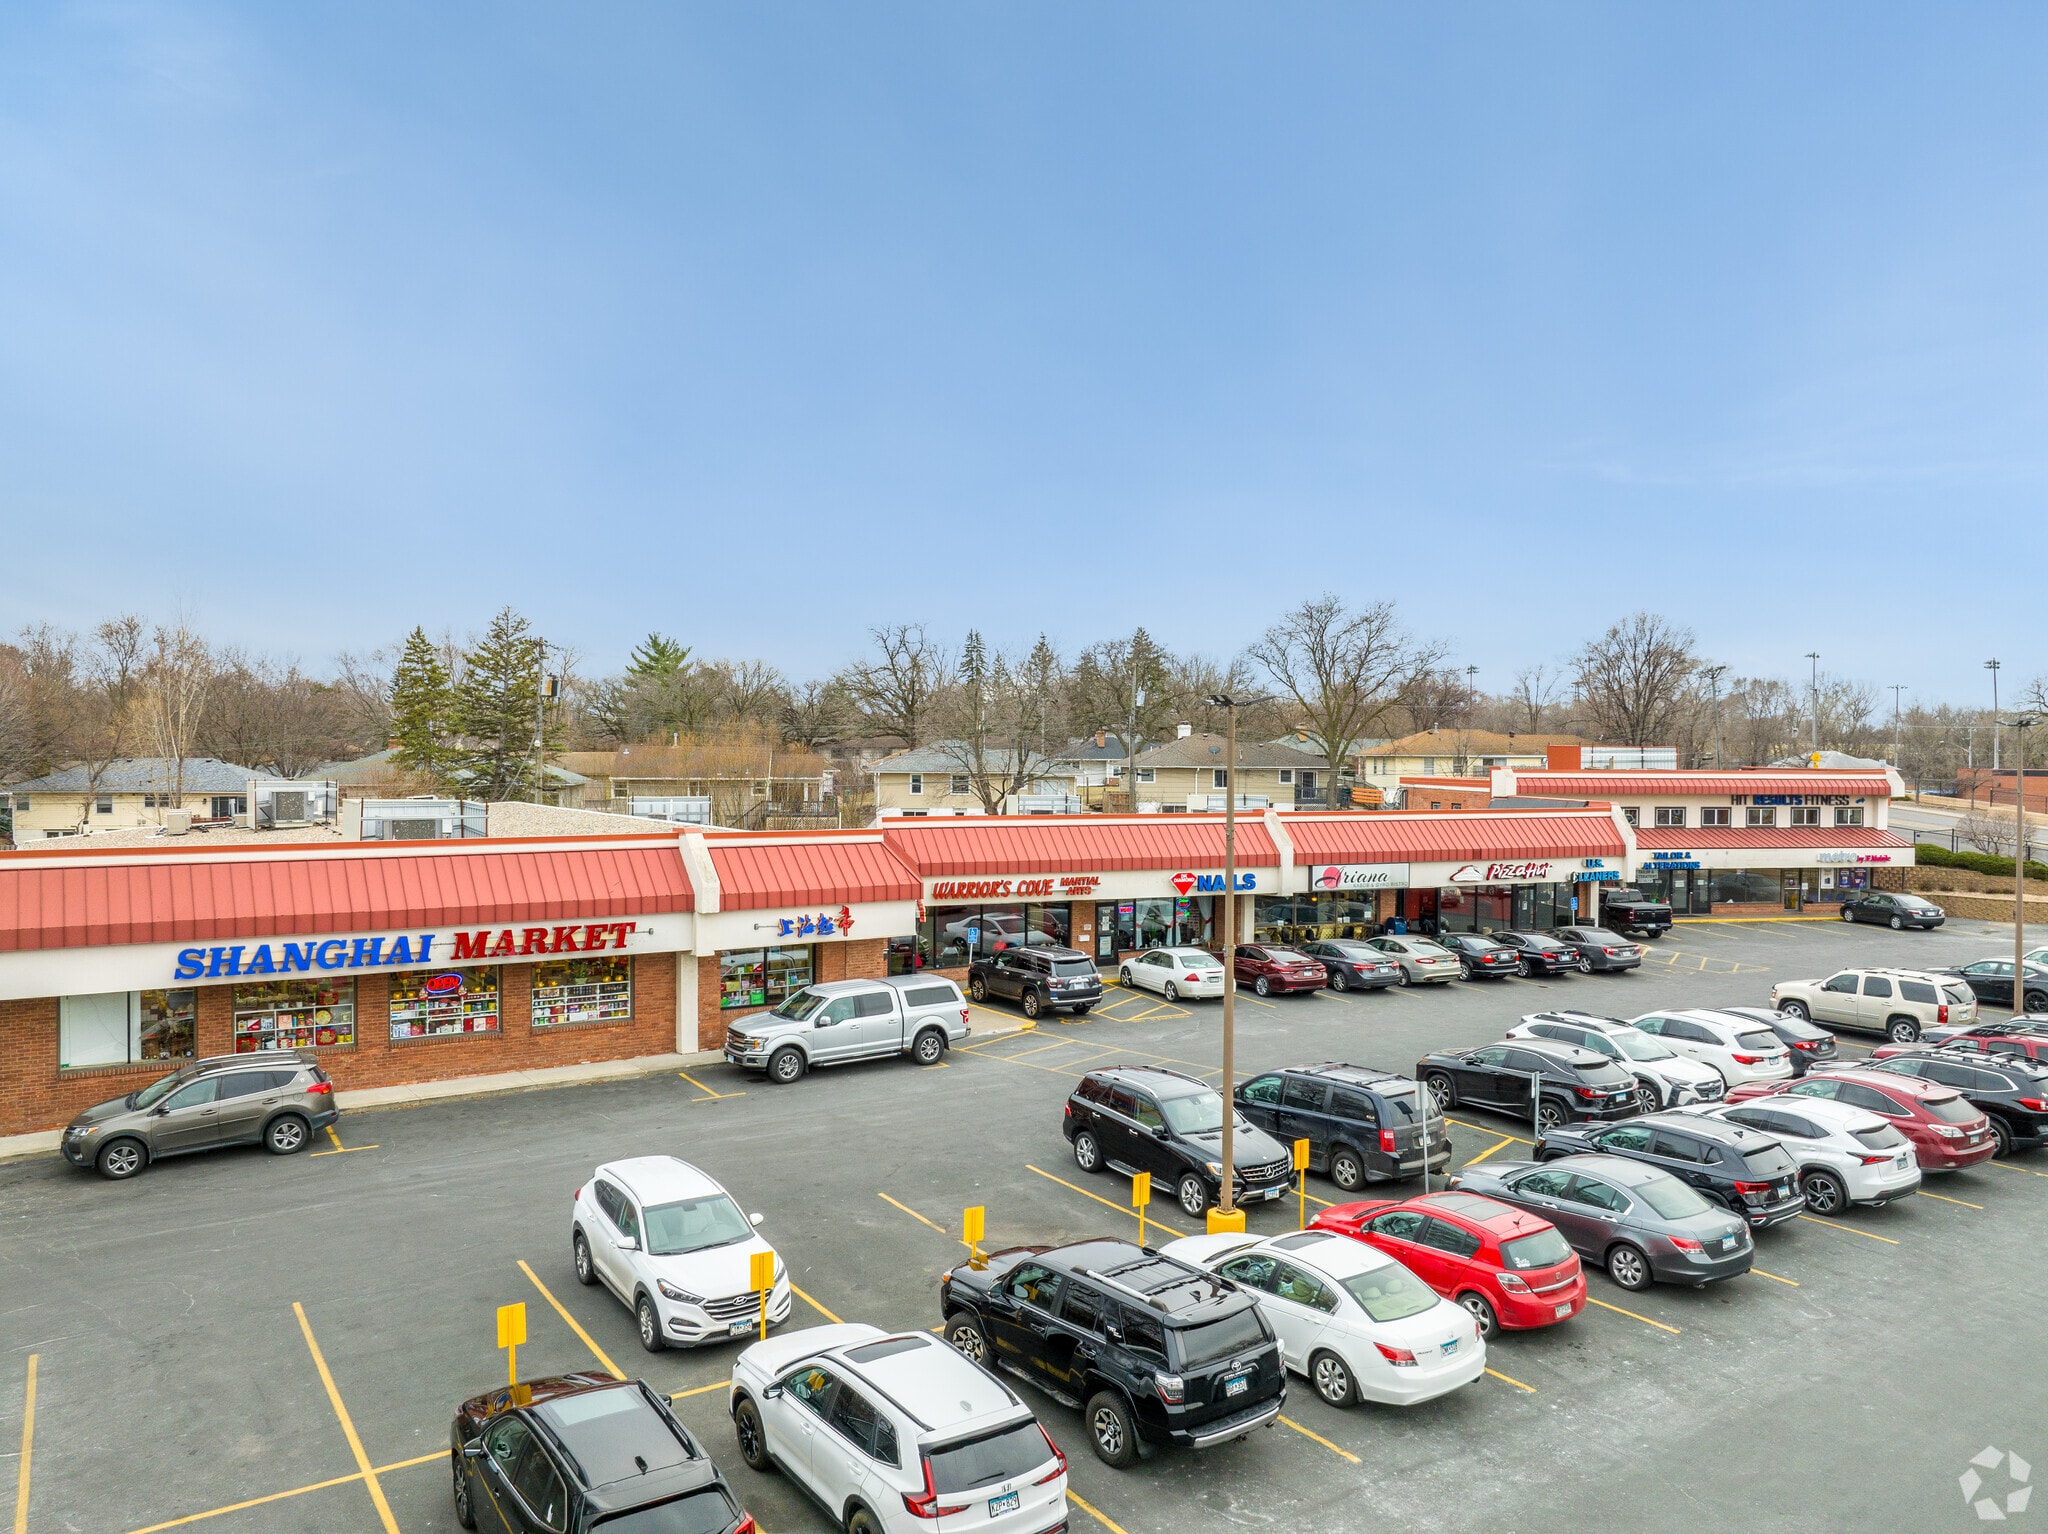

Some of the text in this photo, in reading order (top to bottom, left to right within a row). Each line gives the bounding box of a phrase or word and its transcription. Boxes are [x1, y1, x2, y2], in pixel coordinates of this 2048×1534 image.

[1731, 794, 1850, 806] HIT RESULTS FITNESS
[1487, 862, 1553, 880] Pizza Hut
[1586, 859, 1604, 868] U.S.
[1642, 861, 1701, 869] ALTERATIONS
[1060, 877, 1101, 886] MARTIAL
[1197, 873, 1256, 892] NALS
[1315, 866, 1389, 888] Ariana
[932, 879, 1055, 900] WARRIOR'S COVE
[1066, 886, 1092, 896] ARTS
[174, 921, 637, 980] SHANGHAI MARKET
[427, 975, 460, 991] OPEN
